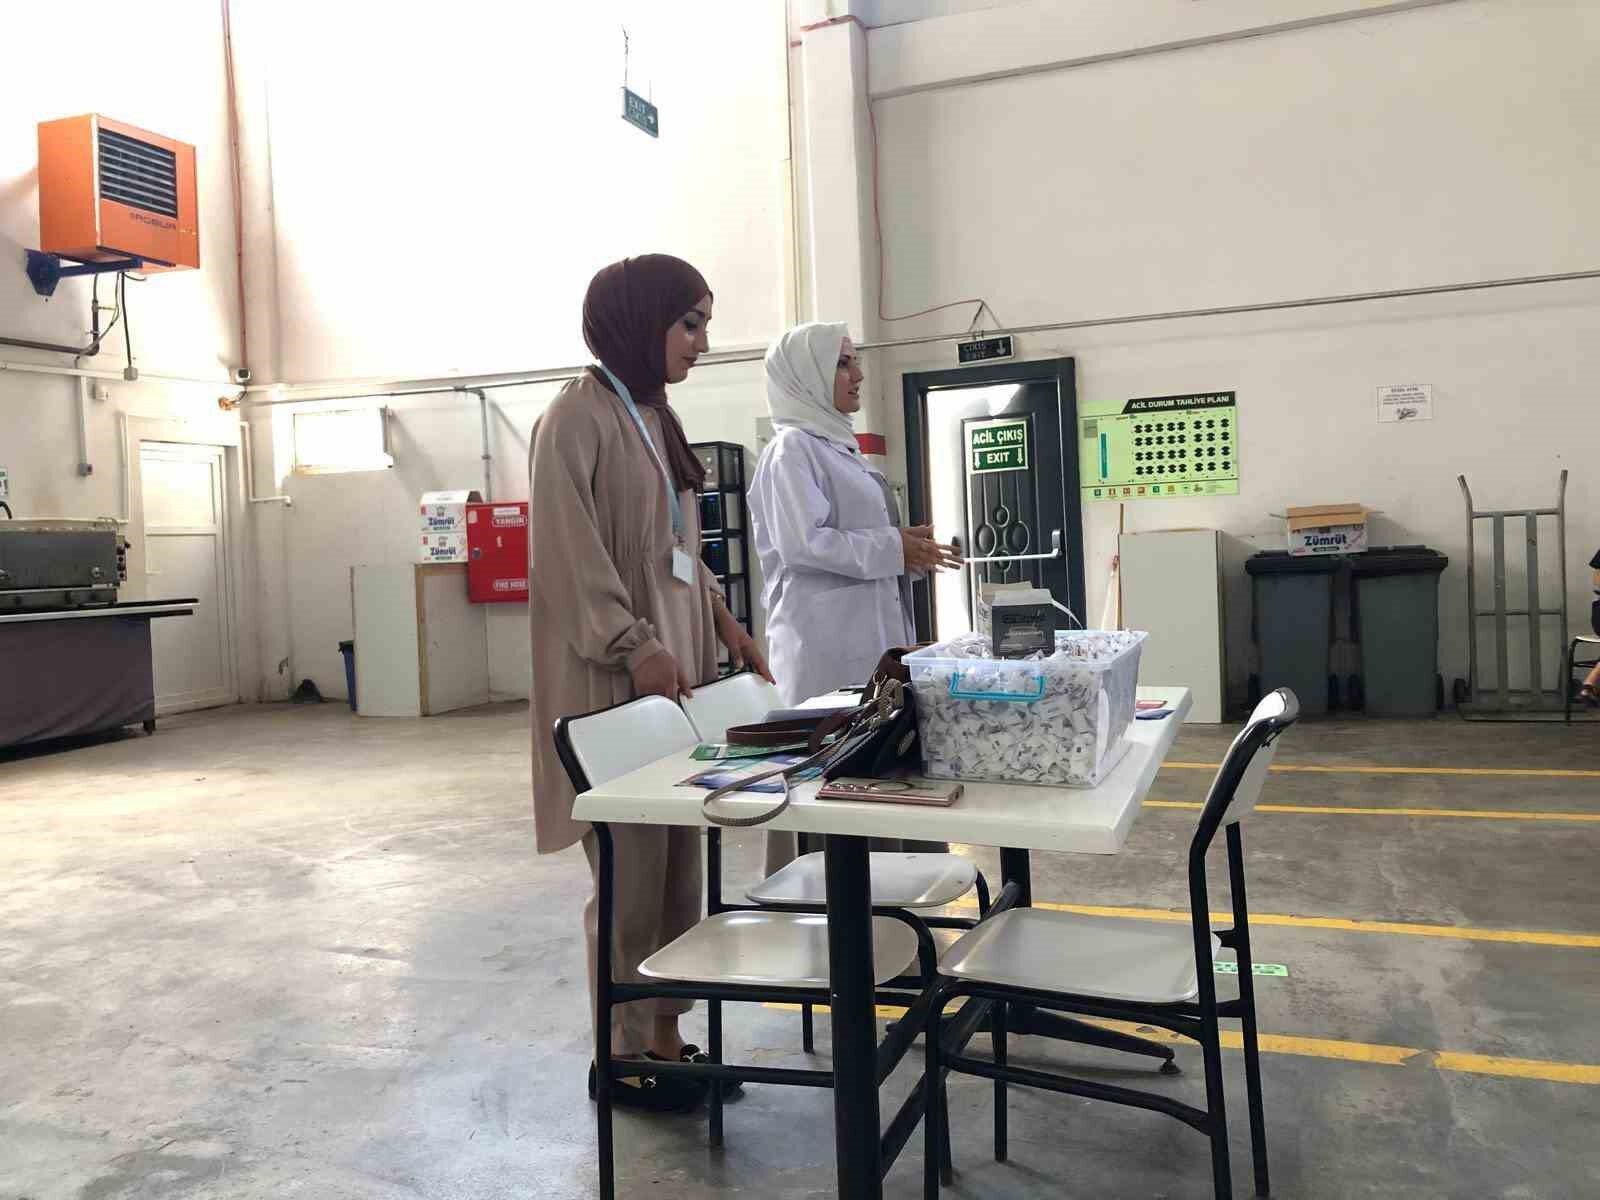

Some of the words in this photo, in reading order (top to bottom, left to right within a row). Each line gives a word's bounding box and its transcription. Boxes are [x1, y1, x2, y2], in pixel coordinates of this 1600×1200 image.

[1132, 401, 1148, 409] ACİL
[1148, 400, 1174, 408] DURUM
[1176, 397, 1206, 406] TAHLİYE
[1207, 395, 1230, 403] PLANI
[973, 429, 995, 445] ACİL
[997, 428, 1024, 444] ÇIKIŞ
[986, 451, 1010, 464] EXIT
[1304, 533, 1346, 546] Zümrüt
